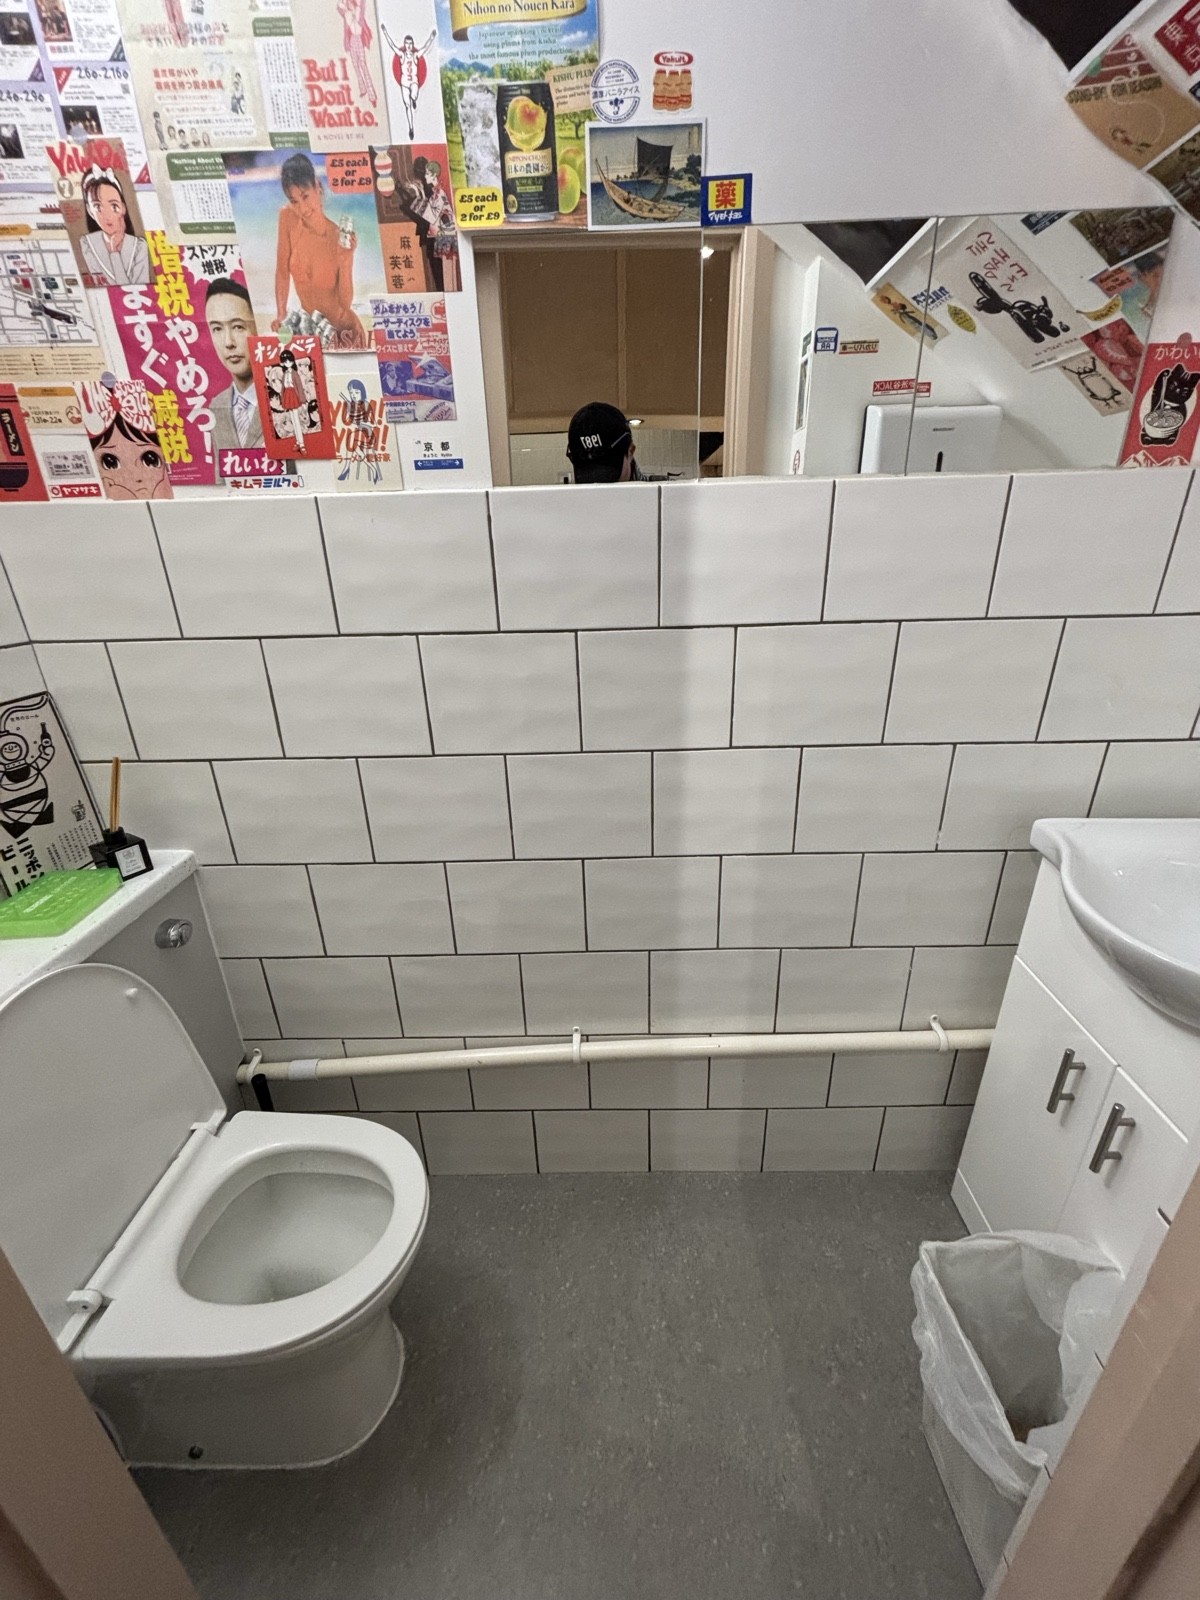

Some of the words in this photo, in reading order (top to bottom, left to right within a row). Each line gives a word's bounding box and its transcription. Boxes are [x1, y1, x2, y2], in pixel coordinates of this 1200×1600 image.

[463, 2, 496, 16] Nihon
[498, 4, 512, 13] no
[302, 59, 338, 82] But
[339, 58, 350, 81] I
[304, 83, 354, 107] Don't
[309, 109, 354, 128] Want
[355, 107, 378, 127] to.
[330, 159, 344, 167] £5
[346, 157, 368, 167] each
[332, 178, 339, 186] 2
[340, 177, 356, 186] for
[357, 177, 372, 186] £9
[459, 196, 472, 204] £5
[472, 194, 498, 203] each
[715, 181, 737, 208] 薬
[474, 204, 485, 212] or
[460, 214, 467, 222] 2
[468, 212, 483, 222] for
[485, 212, 500, 221] £9
[400, 236, 414, 269] 麻雀
[202, 258, 227, 275] 増税
[1154, 346, 1200, 361] かわい
[329, 398, 384, 426] YUM!
[1, 412, 20, 452] ラーメン
[333, 425, 389, 453] YUM!
[423, 441, 450, 452] 京都
[222, 451, 278, 475] れいわ
[230, 477, 292, 489] キムラミルク
